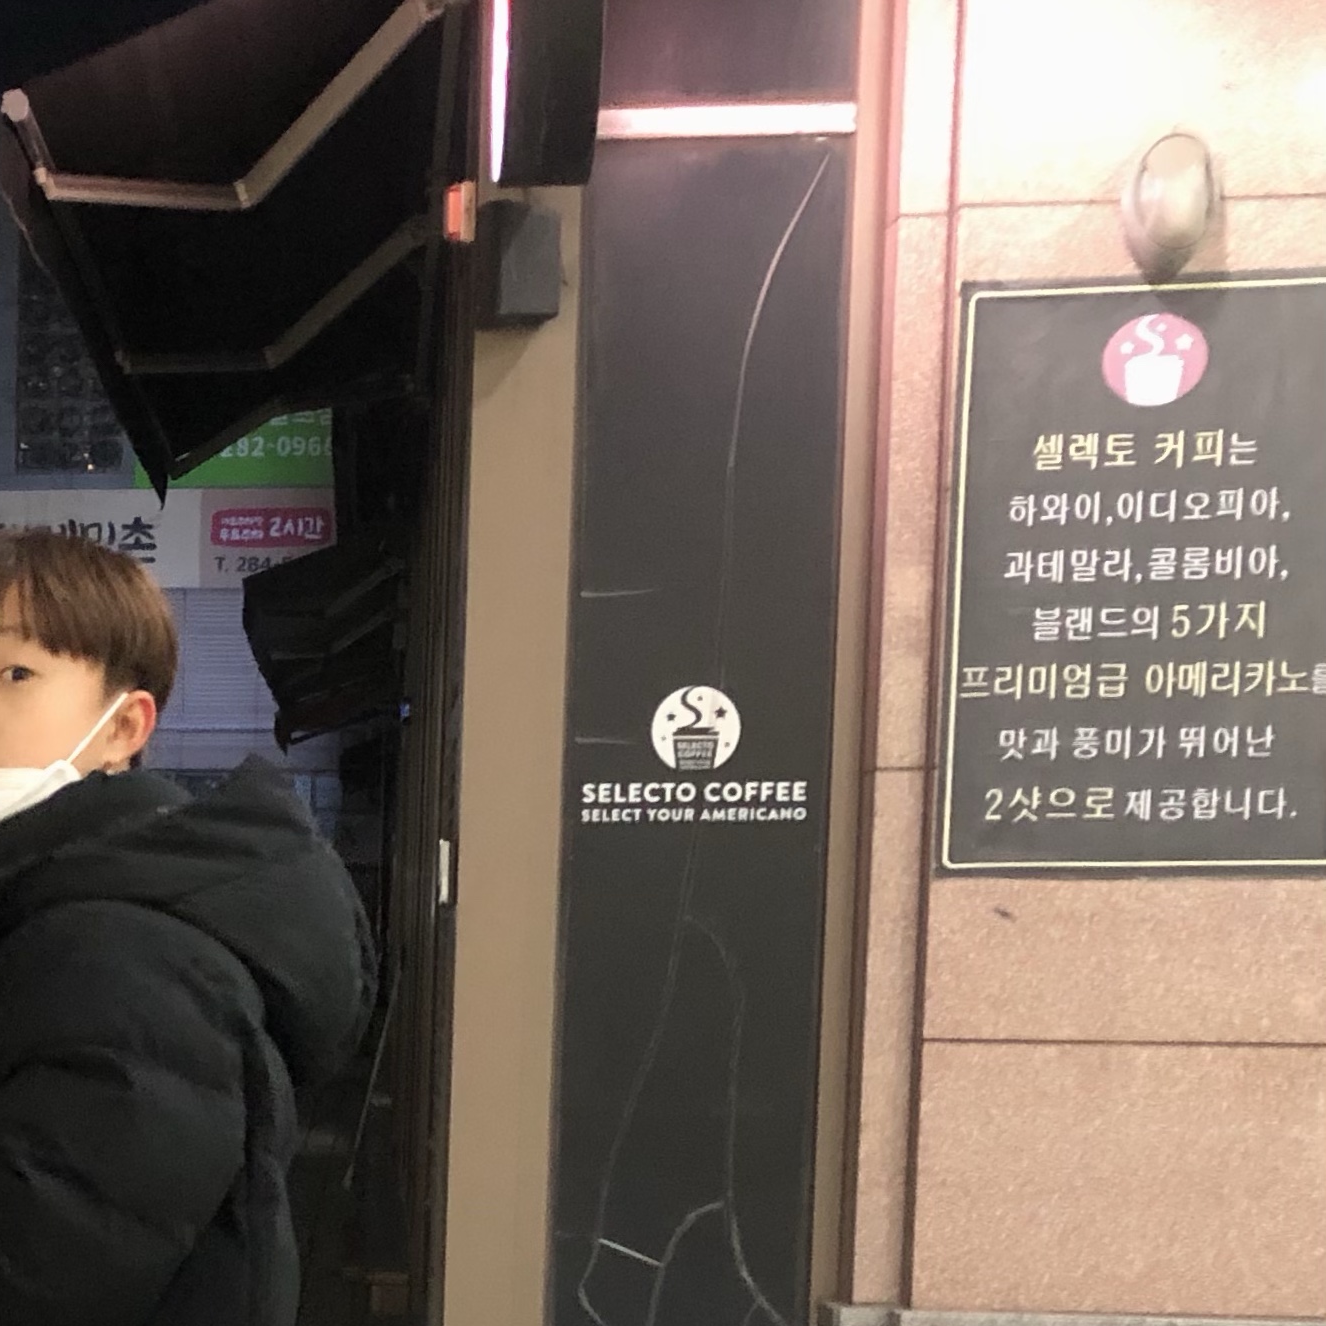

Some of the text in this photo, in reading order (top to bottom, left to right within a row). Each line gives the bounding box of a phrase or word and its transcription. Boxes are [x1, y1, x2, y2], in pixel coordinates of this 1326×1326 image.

[1032, 428, 1259, 472] 셀렉토 커피는
[270, 515, 324, 540] 2시간
[1032, 601, 1266, 641] 블랜드의 5가지
[959, 664, 1128, 700] 프리미엄급
[999, 724, 1275, 759] 맛과 풍미가 뛰어난
[582, 781, 807, 804] SELECTO COFFEE
[985, 786, 1298, 822] 2샷으로 제공합니다.
[581, 807, 807, 823] SELECT YOUR AMERICANO
